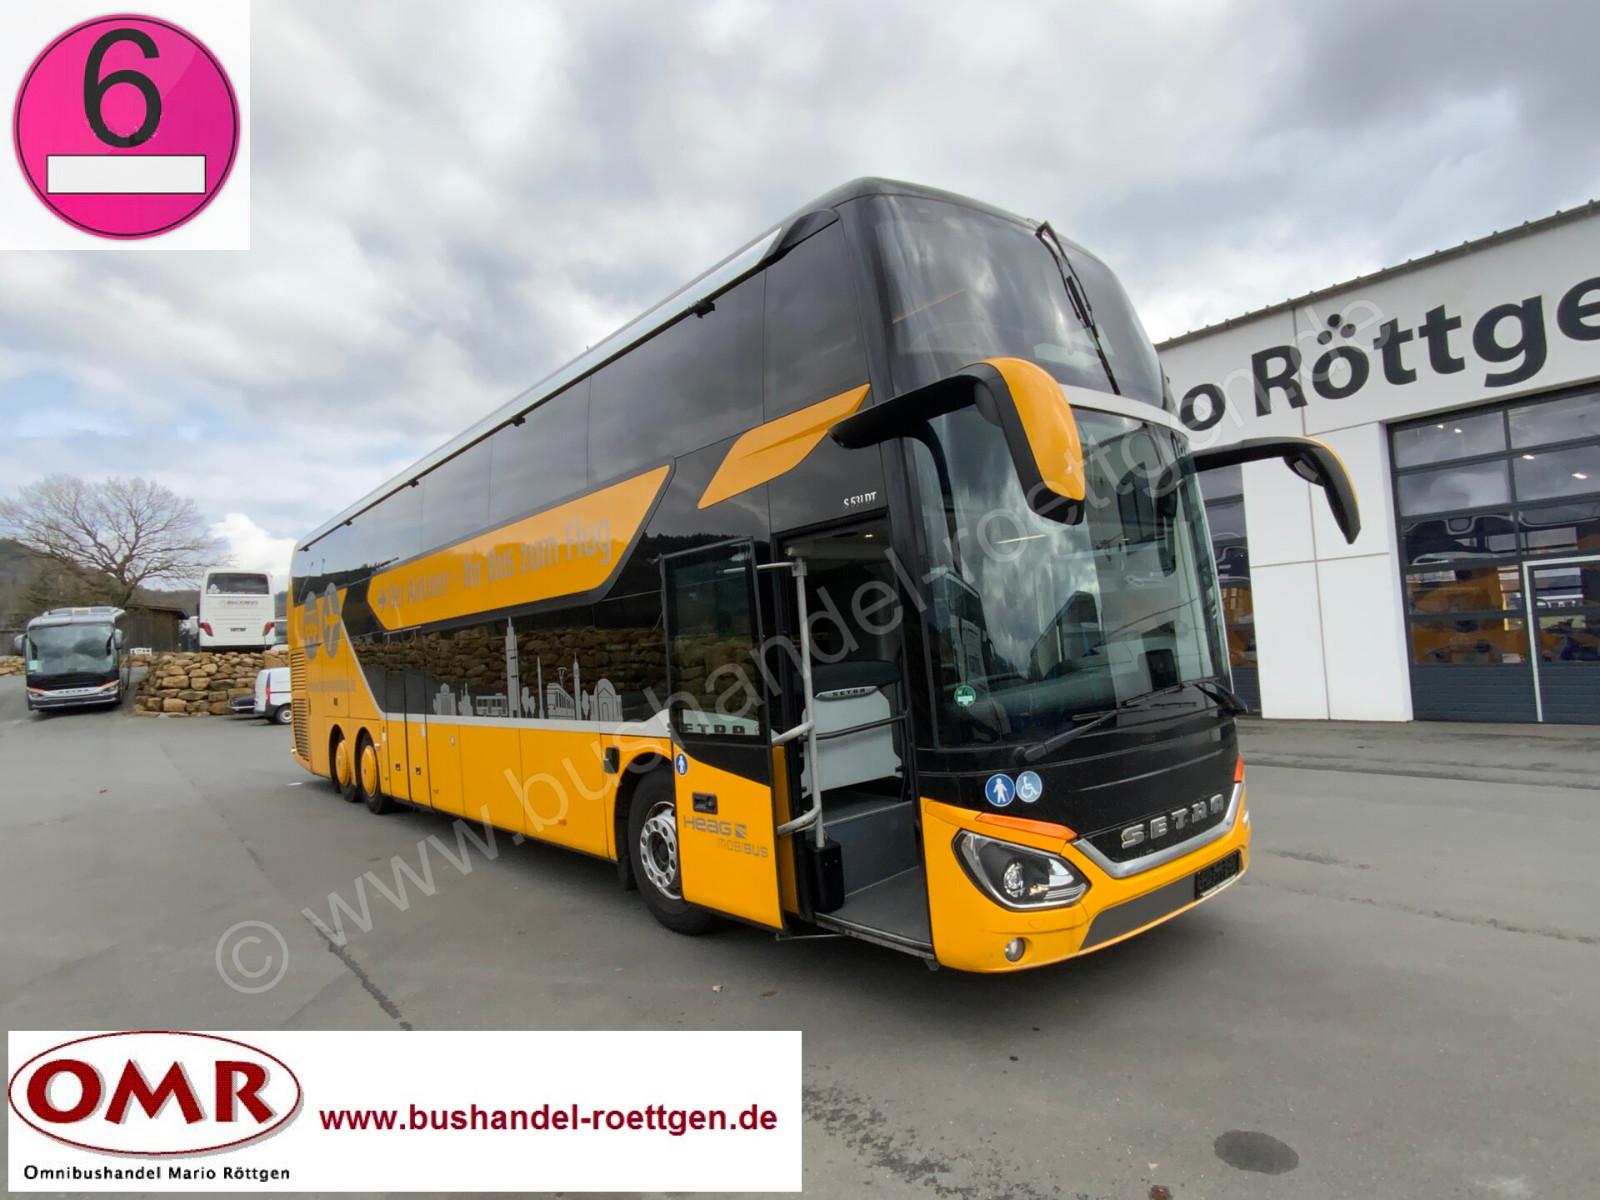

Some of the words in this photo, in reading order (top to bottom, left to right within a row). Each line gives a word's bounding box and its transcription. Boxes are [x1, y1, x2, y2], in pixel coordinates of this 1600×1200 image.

[520, 536, 559, 574] zum
[565, 513, 611, 566] Flug
[1121, 793, 1224, 849] SETRA
